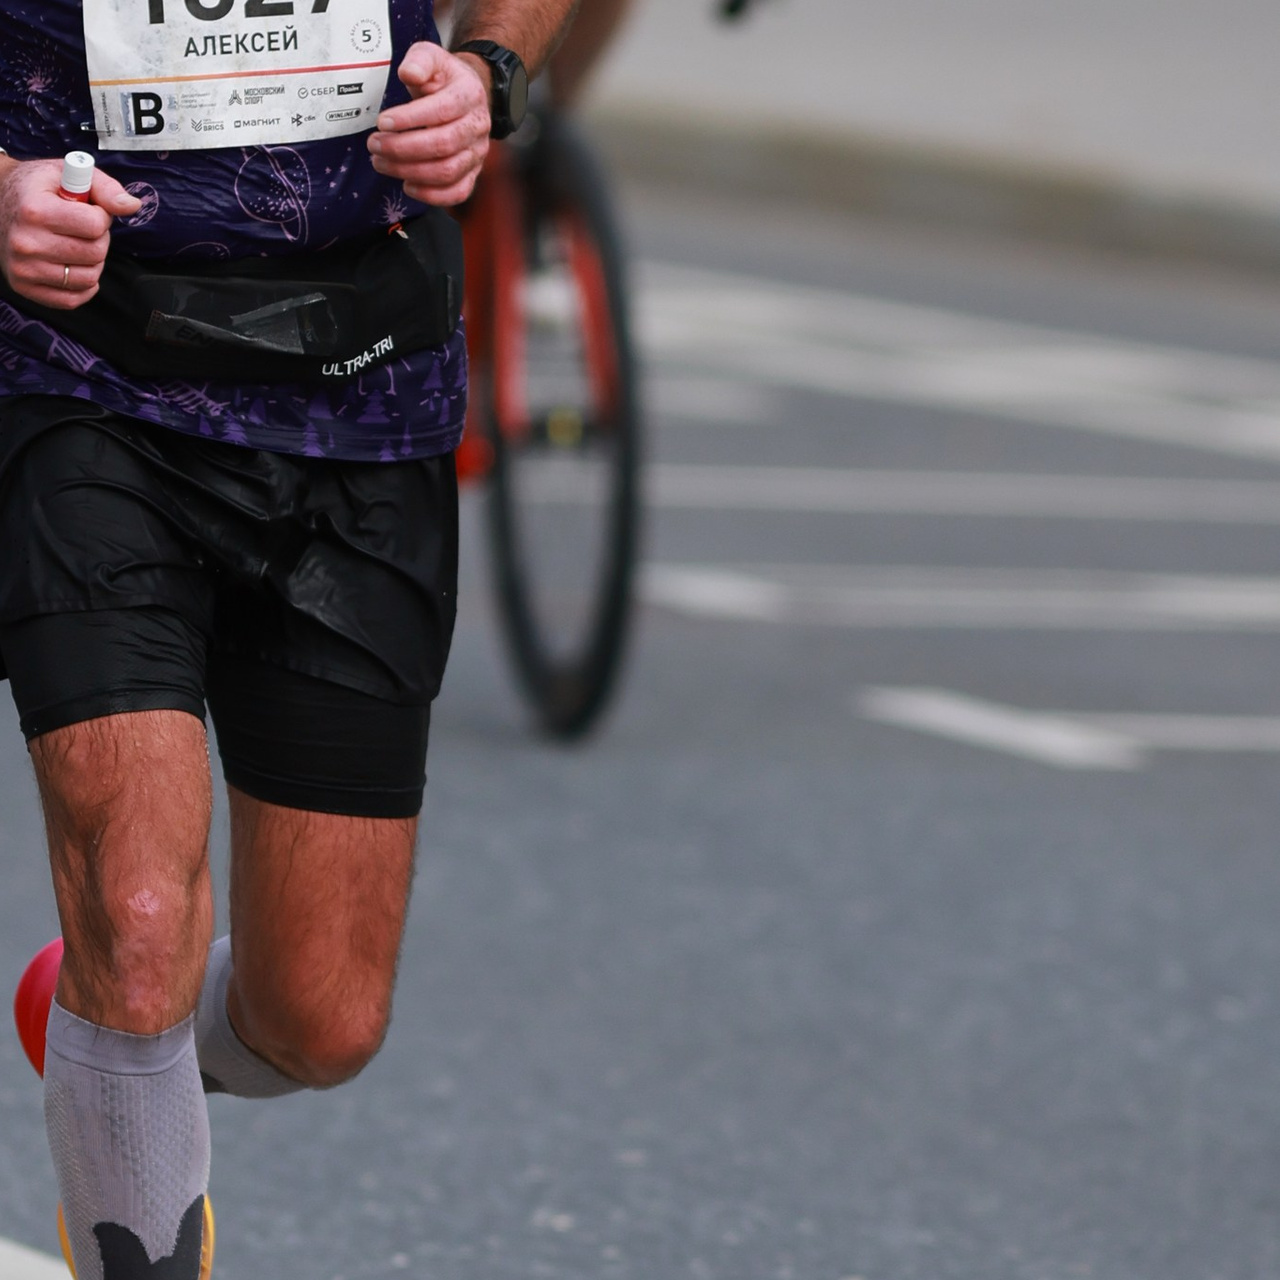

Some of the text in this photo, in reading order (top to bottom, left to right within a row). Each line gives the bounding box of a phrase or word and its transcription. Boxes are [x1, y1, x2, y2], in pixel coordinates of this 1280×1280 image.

[183, 25, 299, 58] АЛЕКСЕЙ
[361, 29, 372, 43] 5
[310, 87, 335, 97] СБЕР
[242, 118, 281, 127] магнит
[322, 335, 394, 376] ULTRA-TRI
